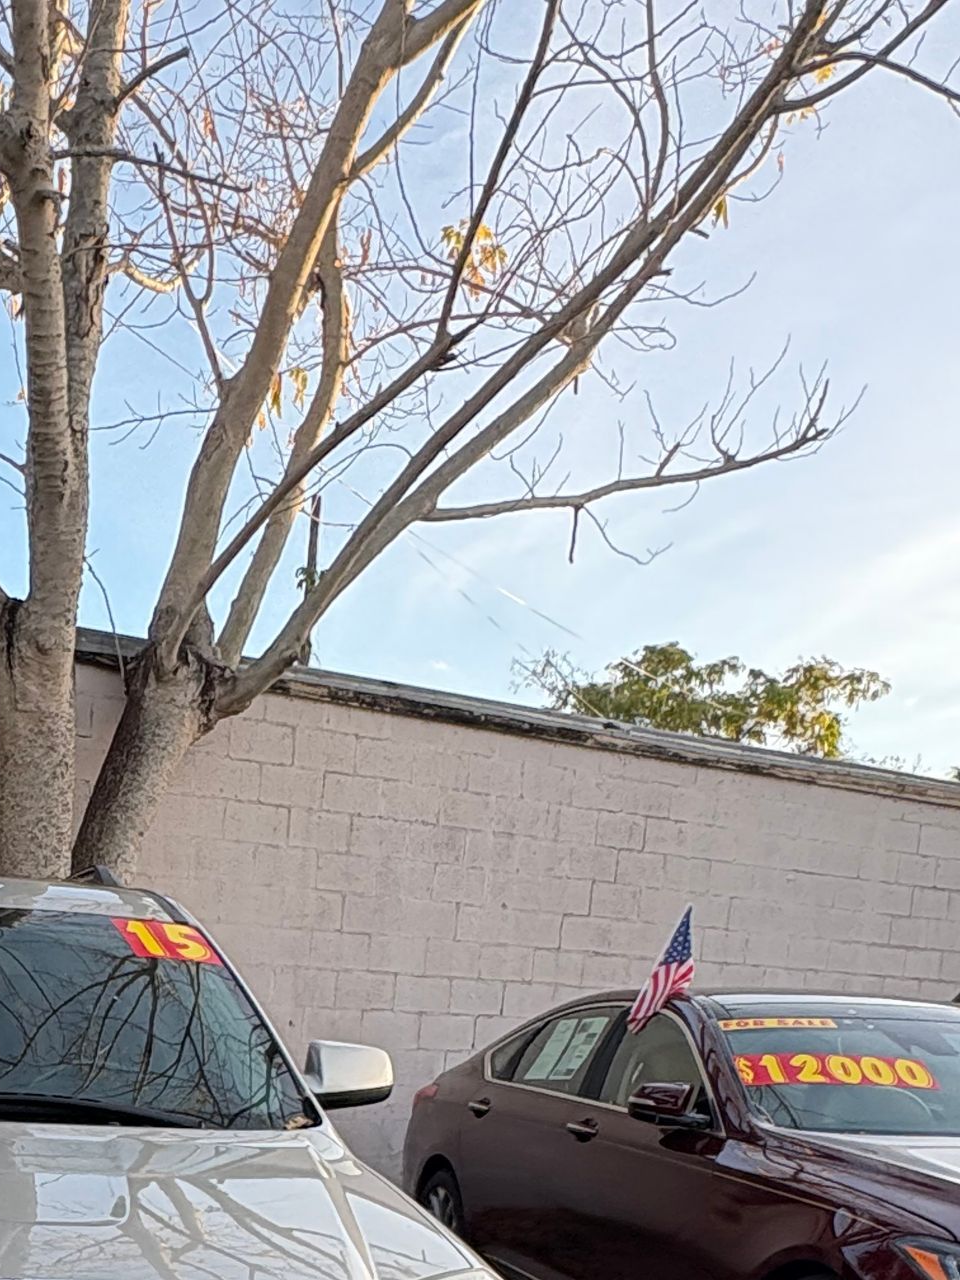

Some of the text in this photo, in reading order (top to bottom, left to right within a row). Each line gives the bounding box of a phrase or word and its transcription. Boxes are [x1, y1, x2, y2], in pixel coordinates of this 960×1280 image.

[126, 921, 212, 960] 15
[722, 1019, 833, 1029] FOR SALE
[735, 1053, 934, 1089] $12000
